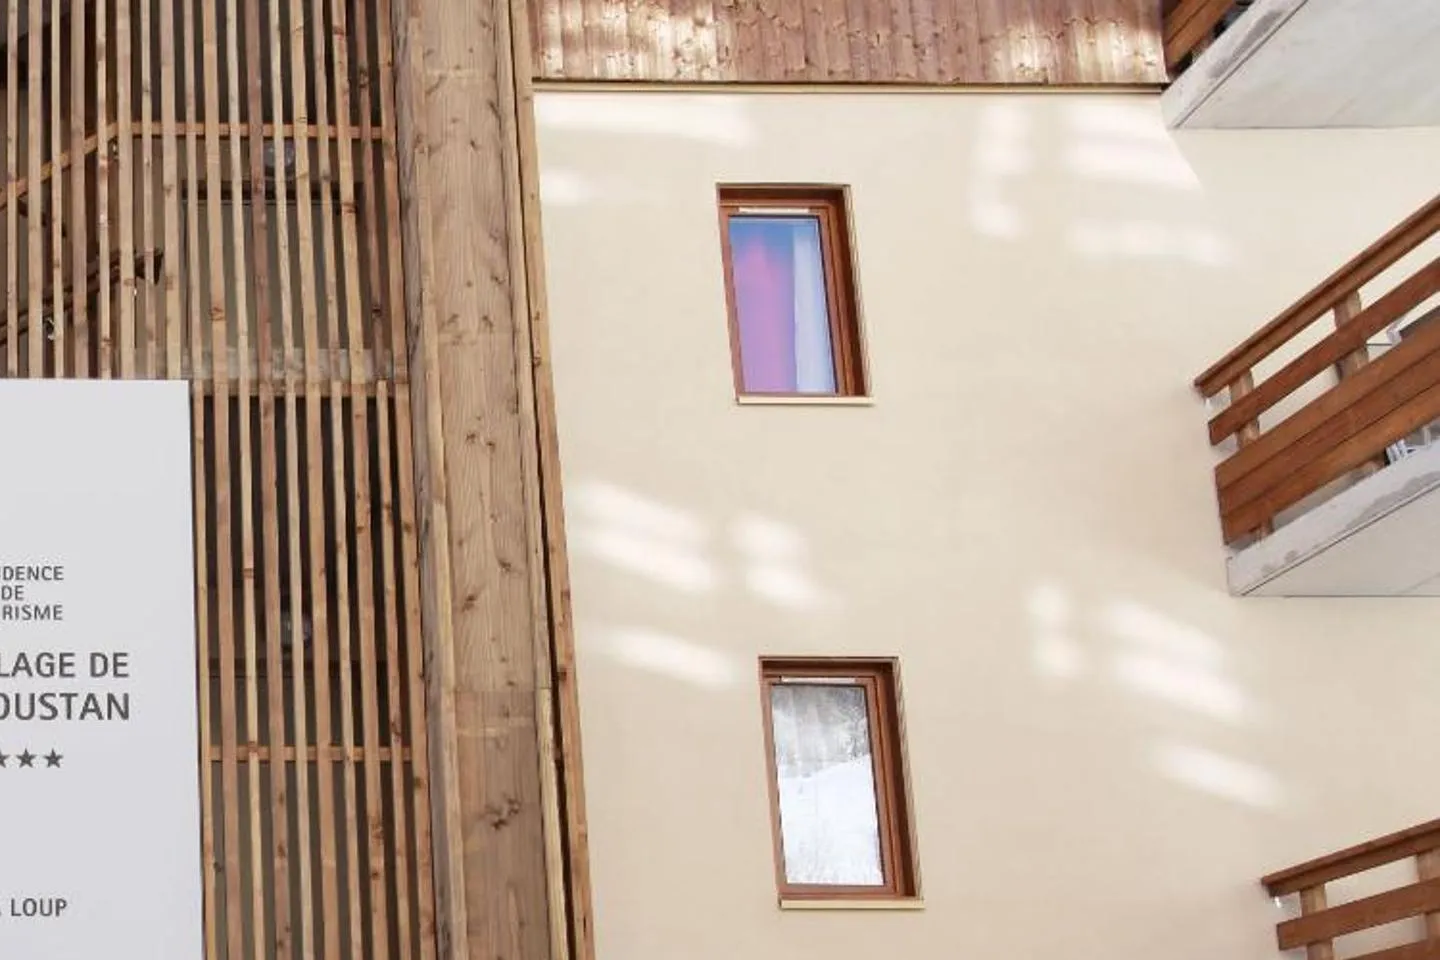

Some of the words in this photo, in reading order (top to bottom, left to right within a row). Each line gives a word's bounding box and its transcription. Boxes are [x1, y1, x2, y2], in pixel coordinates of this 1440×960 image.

[0, 584, 25, 601] DE
[89, 651, 130, 679] DE
[10, 897, 68, 918] LOUP
